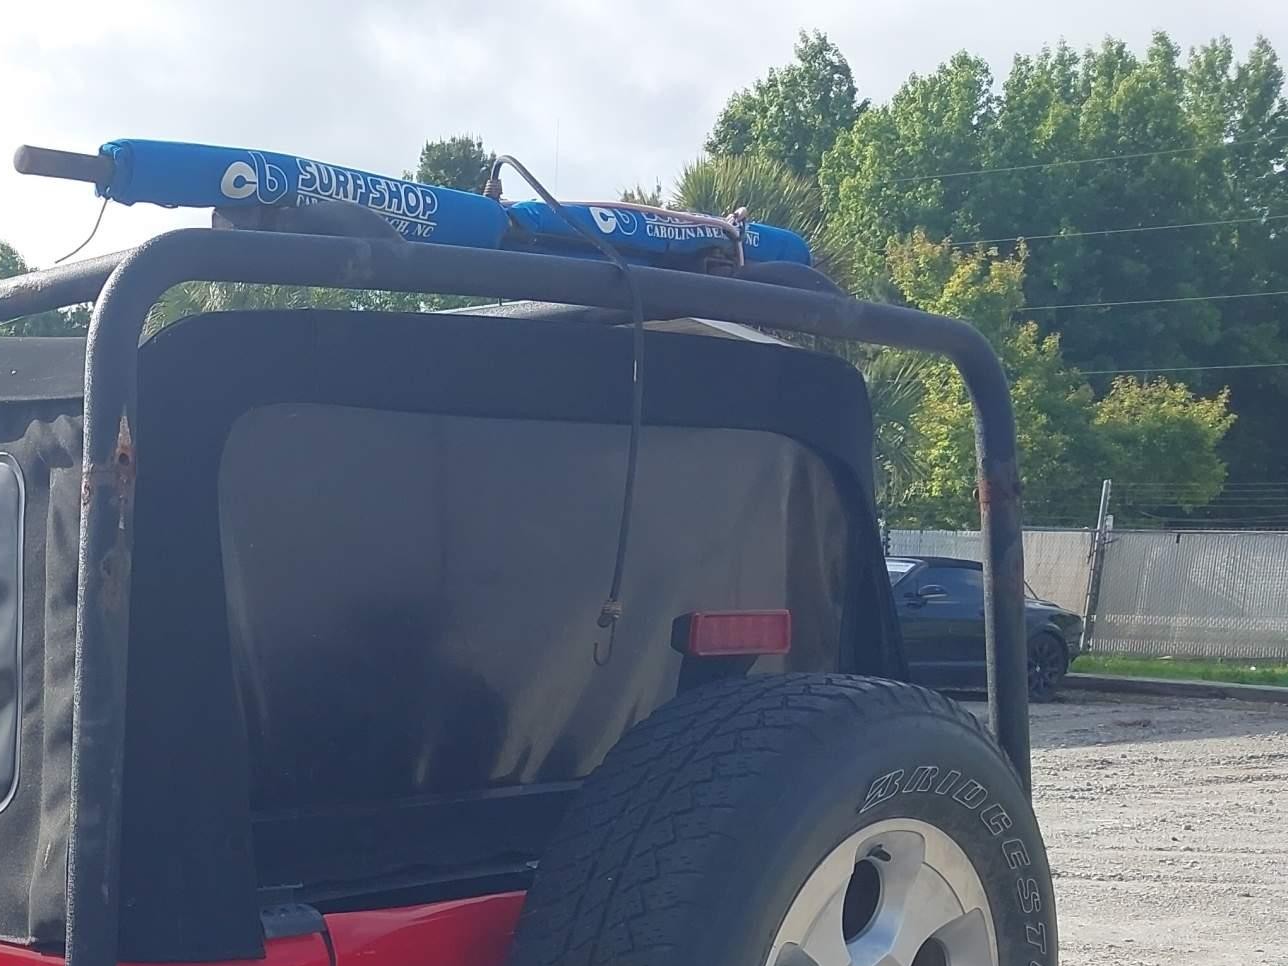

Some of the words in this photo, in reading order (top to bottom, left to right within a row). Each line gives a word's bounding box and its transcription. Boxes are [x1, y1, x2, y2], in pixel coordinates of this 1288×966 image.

[295, 157, 368, 202] SURF
[367, 176, 439, 220] SHOP
[412, 223, 434, 238] NC
[646, 223, 704, 241] CAROLINA
[746, 232, 760, 248] NC
